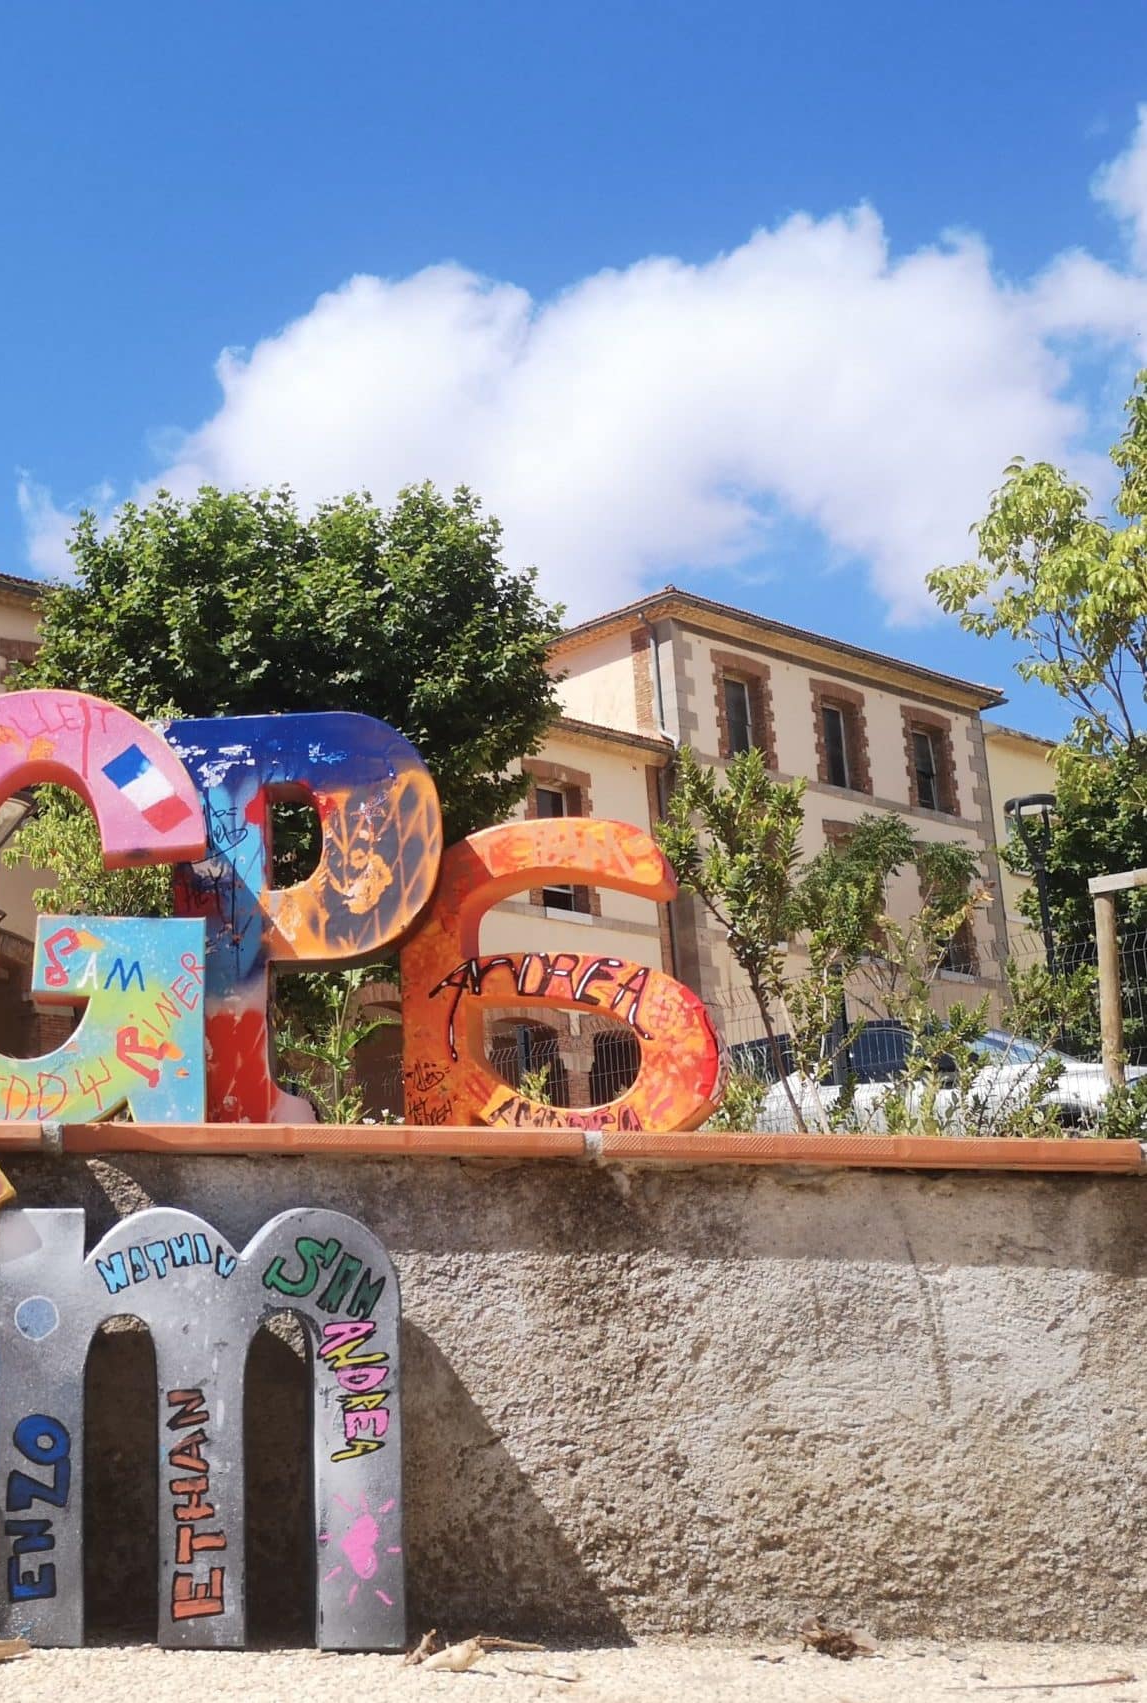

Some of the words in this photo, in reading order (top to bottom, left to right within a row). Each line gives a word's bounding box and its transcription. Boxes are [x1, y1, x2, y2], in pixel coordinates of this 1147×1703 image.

[43, 927, 145, 988] SAM
[429, 952, 654, 1063] ANDREA
[262, 1235, 386, 1319] SAM
[318, 1319, 391, 1463] ANDREA
[4, 1413, 72, 1602] ENZO
[165, 1388, 228, 1622] ETHAN
